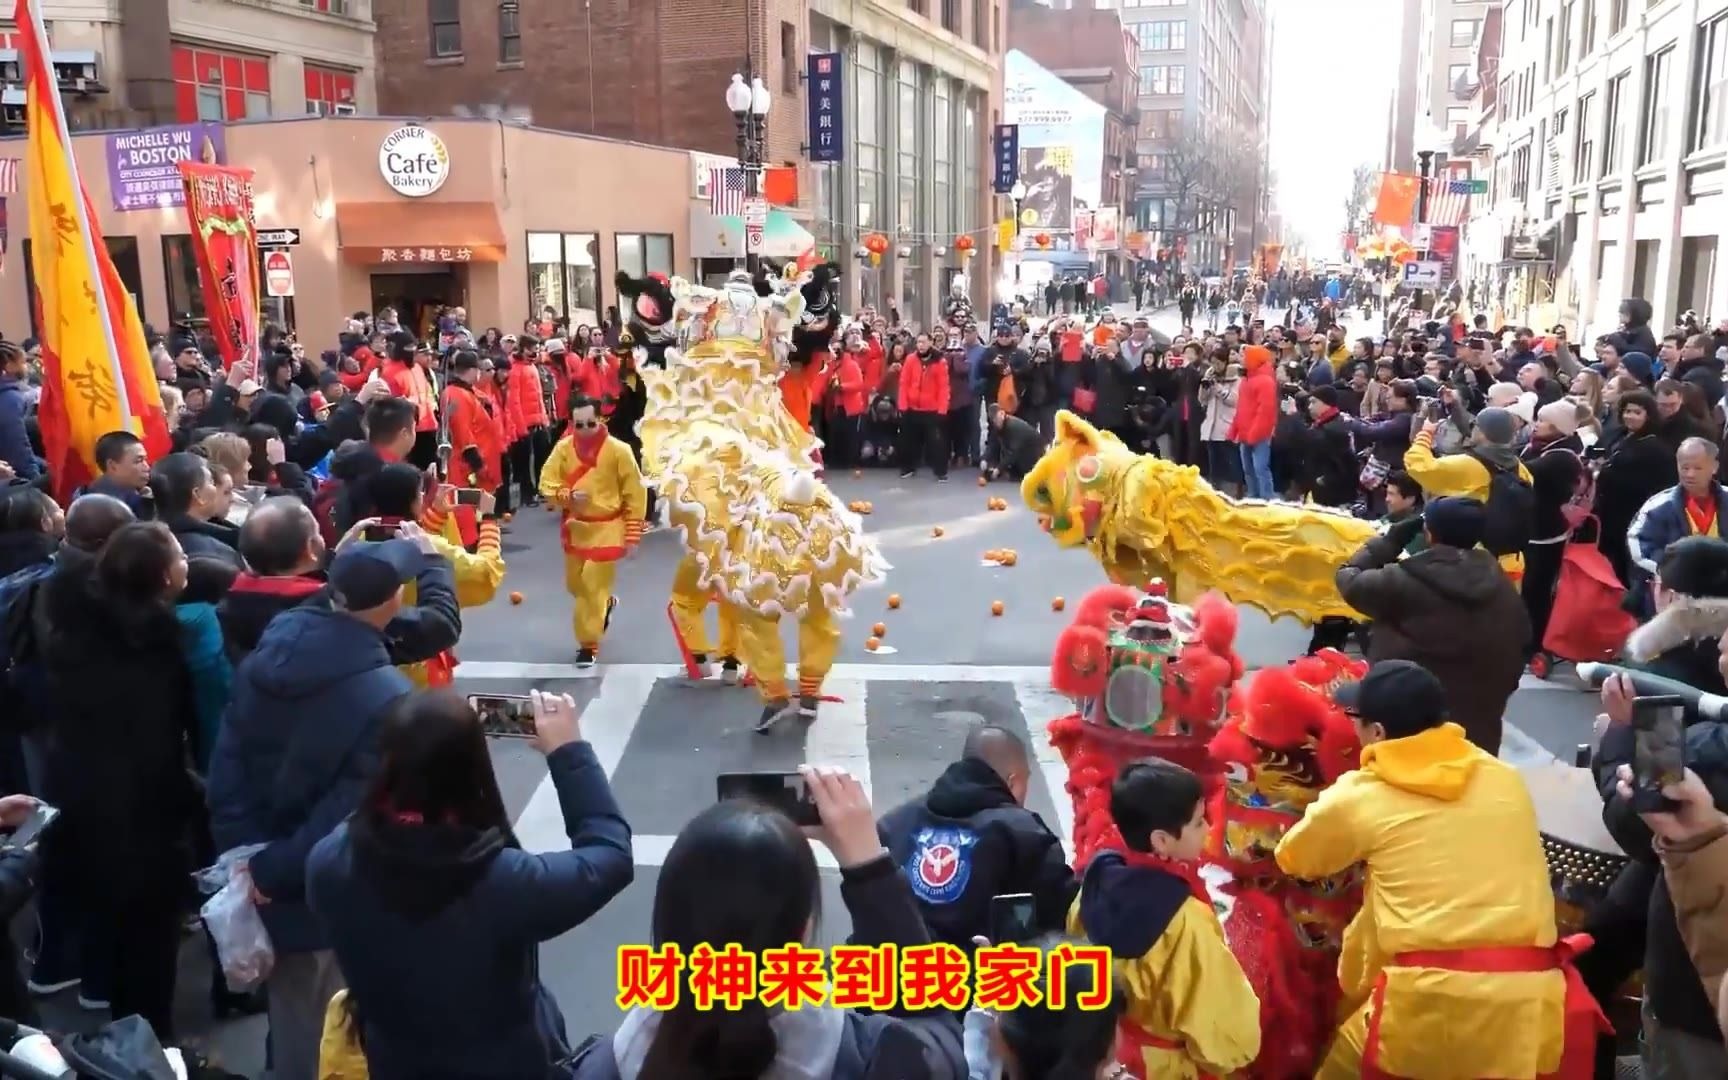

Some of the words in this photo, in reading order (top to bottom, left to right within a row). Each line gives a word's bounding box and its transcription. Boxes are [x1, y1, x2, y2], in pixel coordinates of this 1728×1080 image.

[818, 79, 832, 146] 華美銀行
[115, 133, 170, 151] MICHELLE
[172, 130, 192, 145] WU
[383, 128, 425, 153] CORNER
[130, 144, 192, 166] BOSTON
[387, 152, 439, 175] Café
[392, 174, 433, 190] Bakery
[1404, 263, 1420, 281] P
